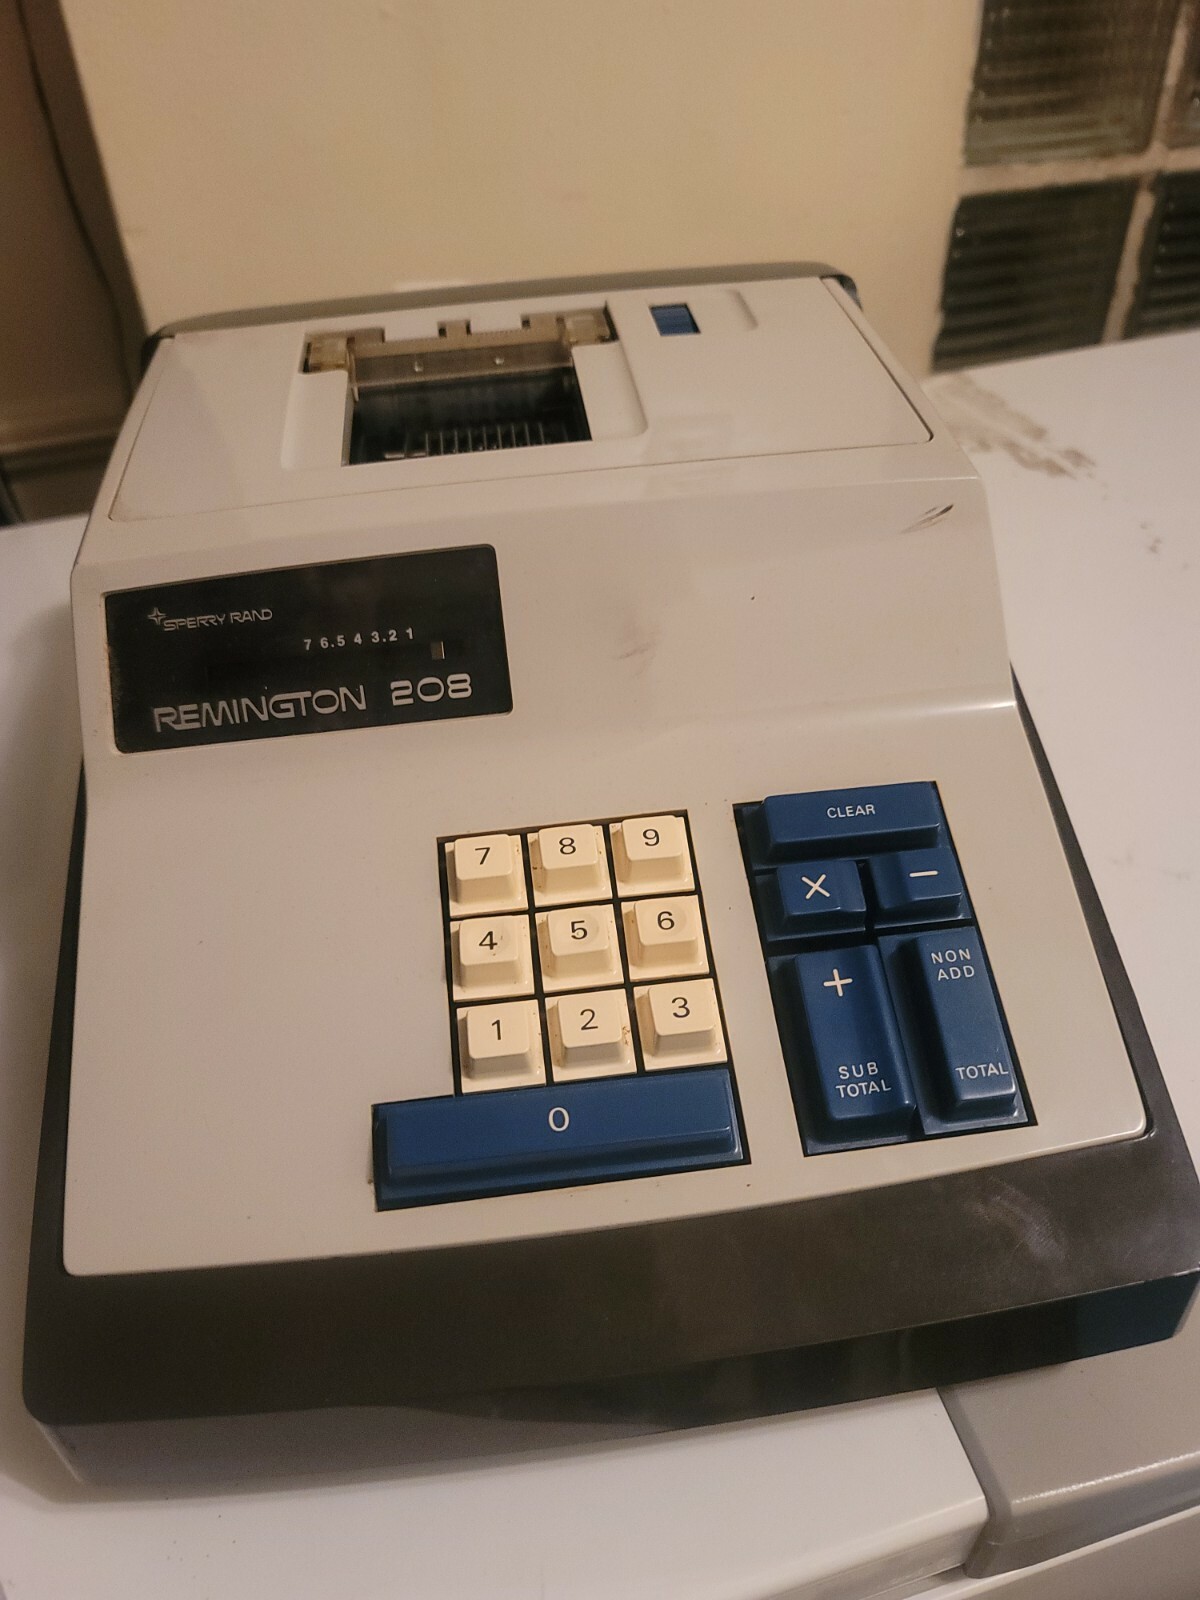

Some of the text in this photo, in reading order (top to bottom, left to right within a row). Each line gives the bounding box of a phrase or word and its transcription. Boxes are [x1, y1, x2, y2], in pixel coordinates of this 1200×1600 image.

[163, 608, 273, 631] SPERRY RAND
[303, 638, 312, 651] 7
[354, 632, 363, 645] 4
[406, 627, 414, 640] 1
[152, 673, 473, 732] REMINGTON 208
[826, 803, 876, 819] CLEAR
[559, 837, 577, 855] 8
[642, 828, 660, 847] 9
[474, 846, 491, 865] 7
[570, 920, 588, 940] 5
[656, 911, 675, 930] 6
[478, 930, 498, 950] 4
[931, 948, 971, 964] NON
[937, 964, 975, 981] ADD
[823, 969, 853, 997] +
[671, 997, 691, 1019] 3
[579, 1008, 598, 1030] 2
[490, 1019, 502, 1041] 1
[838, 1061, 879, 1080] SUB
[955, 1062, 1009, 1081] TOTAL
[836, 1078, 891, 1099] TOTAL
[548, 1107, 570, 1132] 0
